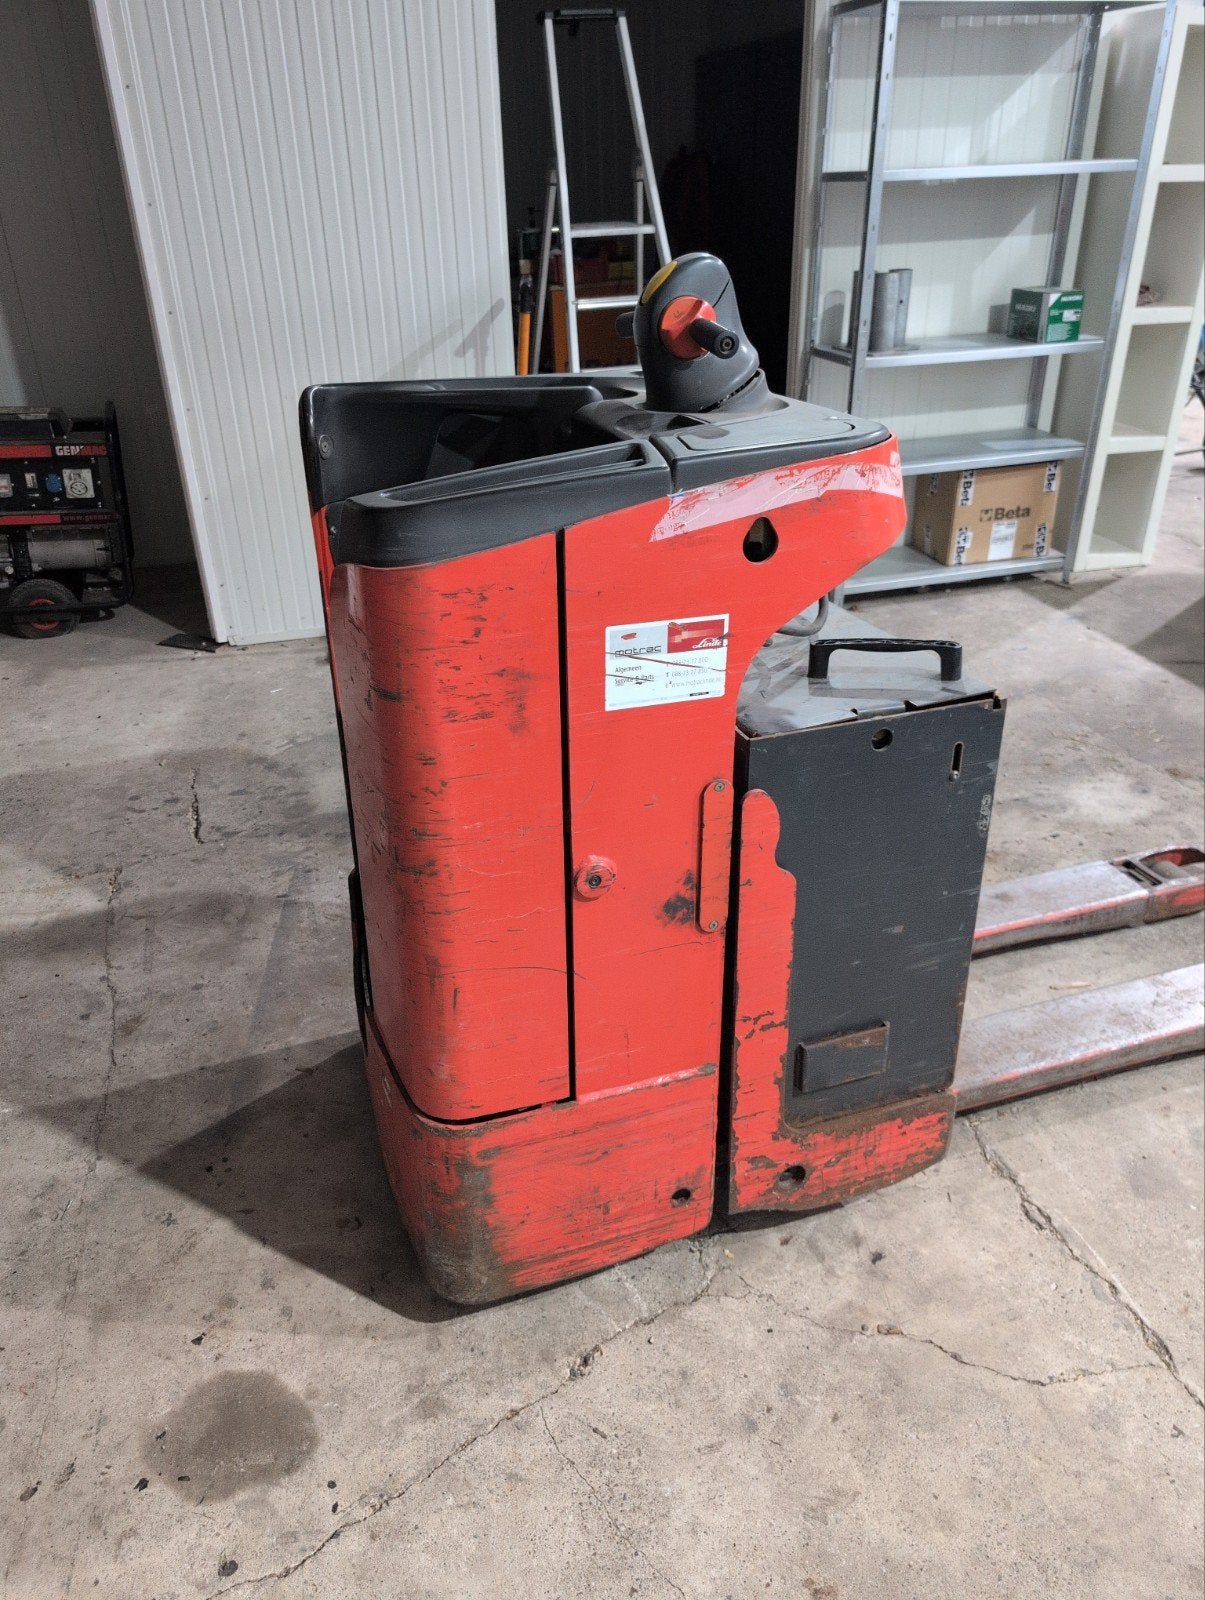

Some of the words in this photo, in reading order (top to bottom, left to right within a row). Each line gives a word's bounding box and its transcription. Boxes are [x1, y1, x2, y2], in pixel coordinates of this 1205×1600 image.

[994, 505, 1031, 520] Beta
[692, 637, 722, 649] Linde
[615, 645, 661, 658] motrac
[615, 665, 642, 674] Algemeen
